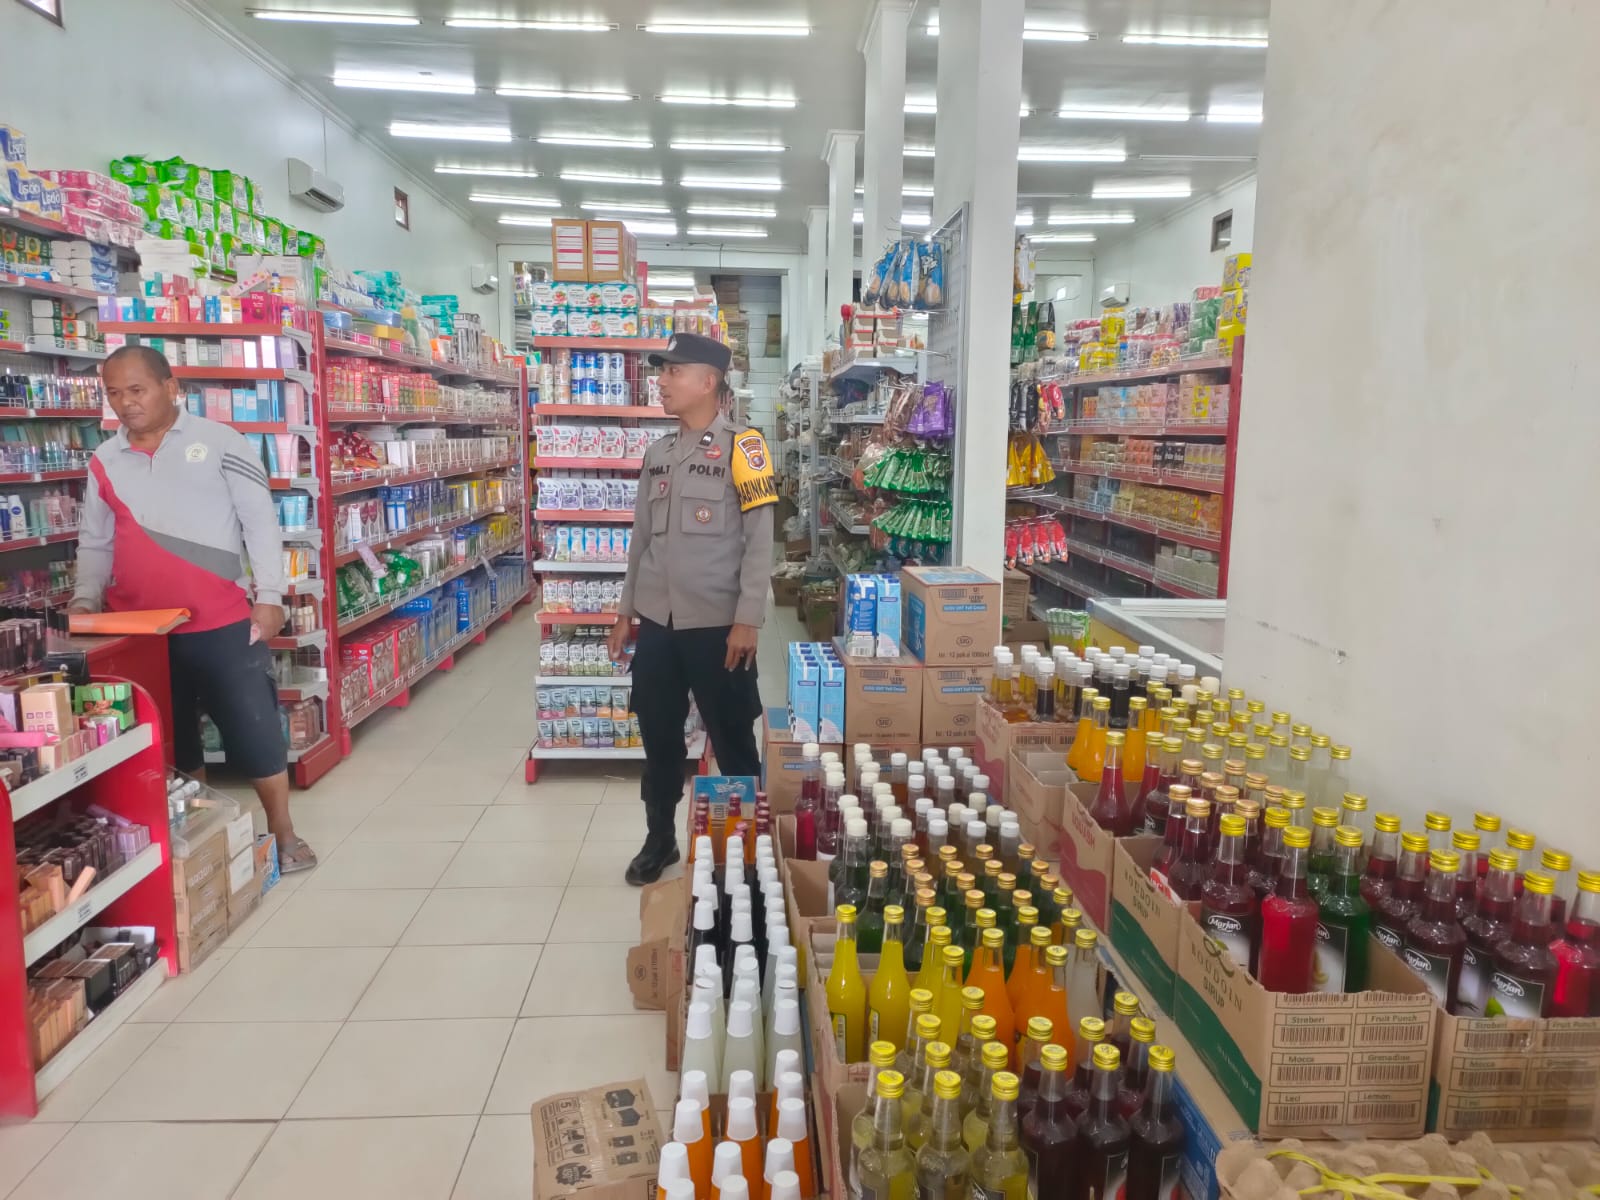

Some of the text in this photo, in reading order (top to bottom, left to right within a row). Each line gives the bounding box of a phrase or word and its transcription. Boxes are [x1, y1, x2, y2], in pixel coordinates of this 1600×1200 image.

[689, 463, 725, 478] POLRI
[1209, 917, 1240, 931] Marjan
[1493, 975, 1522, 996] Marjan
